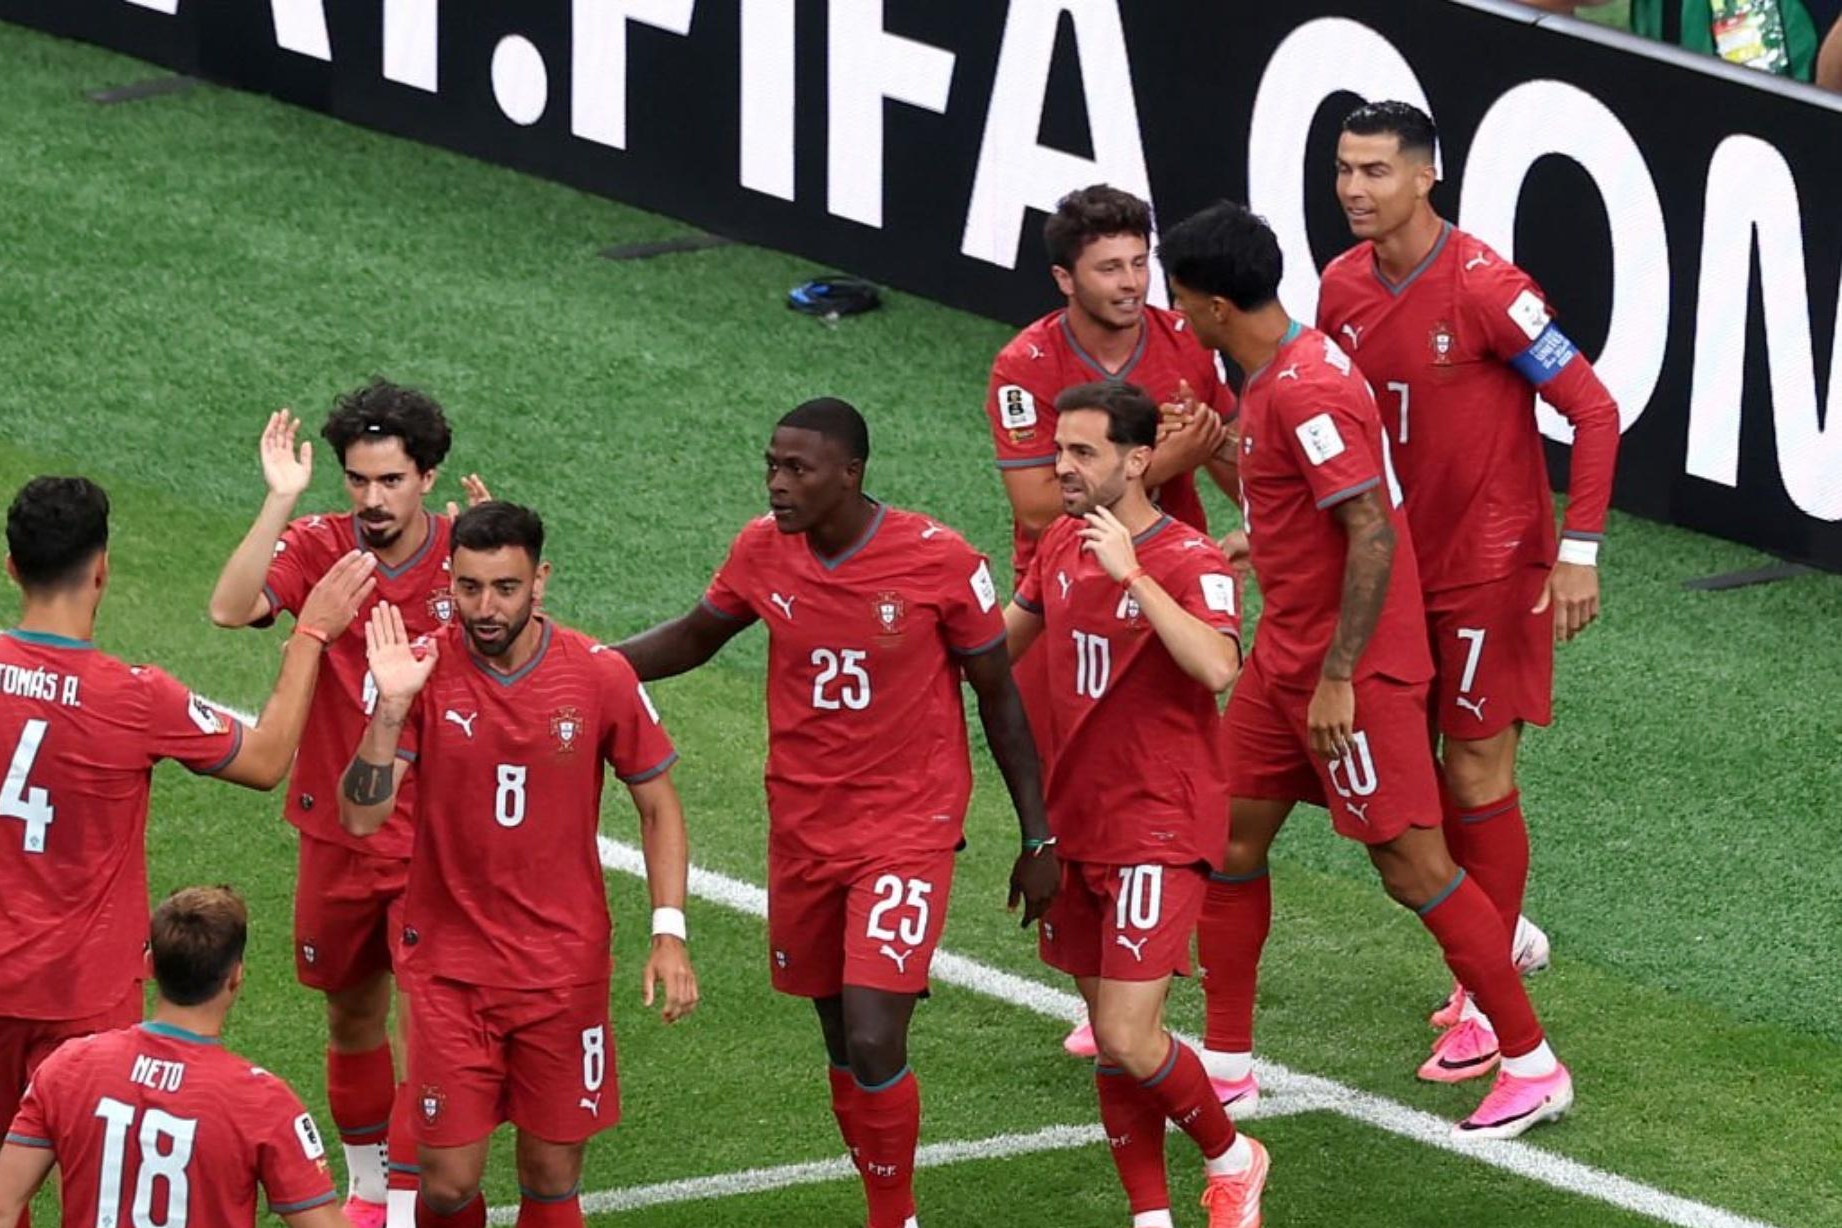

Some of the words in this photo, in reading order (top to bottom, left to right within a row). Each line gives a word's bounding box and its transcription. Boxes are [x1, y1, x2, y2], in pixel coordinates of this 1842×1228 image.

[61, 675, 82, 708] A.
[811, 648, 872, 710] 25
[1072, 630, 1111, 699] 10
[1457, 627, 1486, 693] 7
[494, 763, 528, 828] 8
[866, 874, 933, 947] 25
[1115, 864, 1163, 930] 10
[130, 1054, 186, 1092] NETO
[581, 1025, 606, 1092] 8
